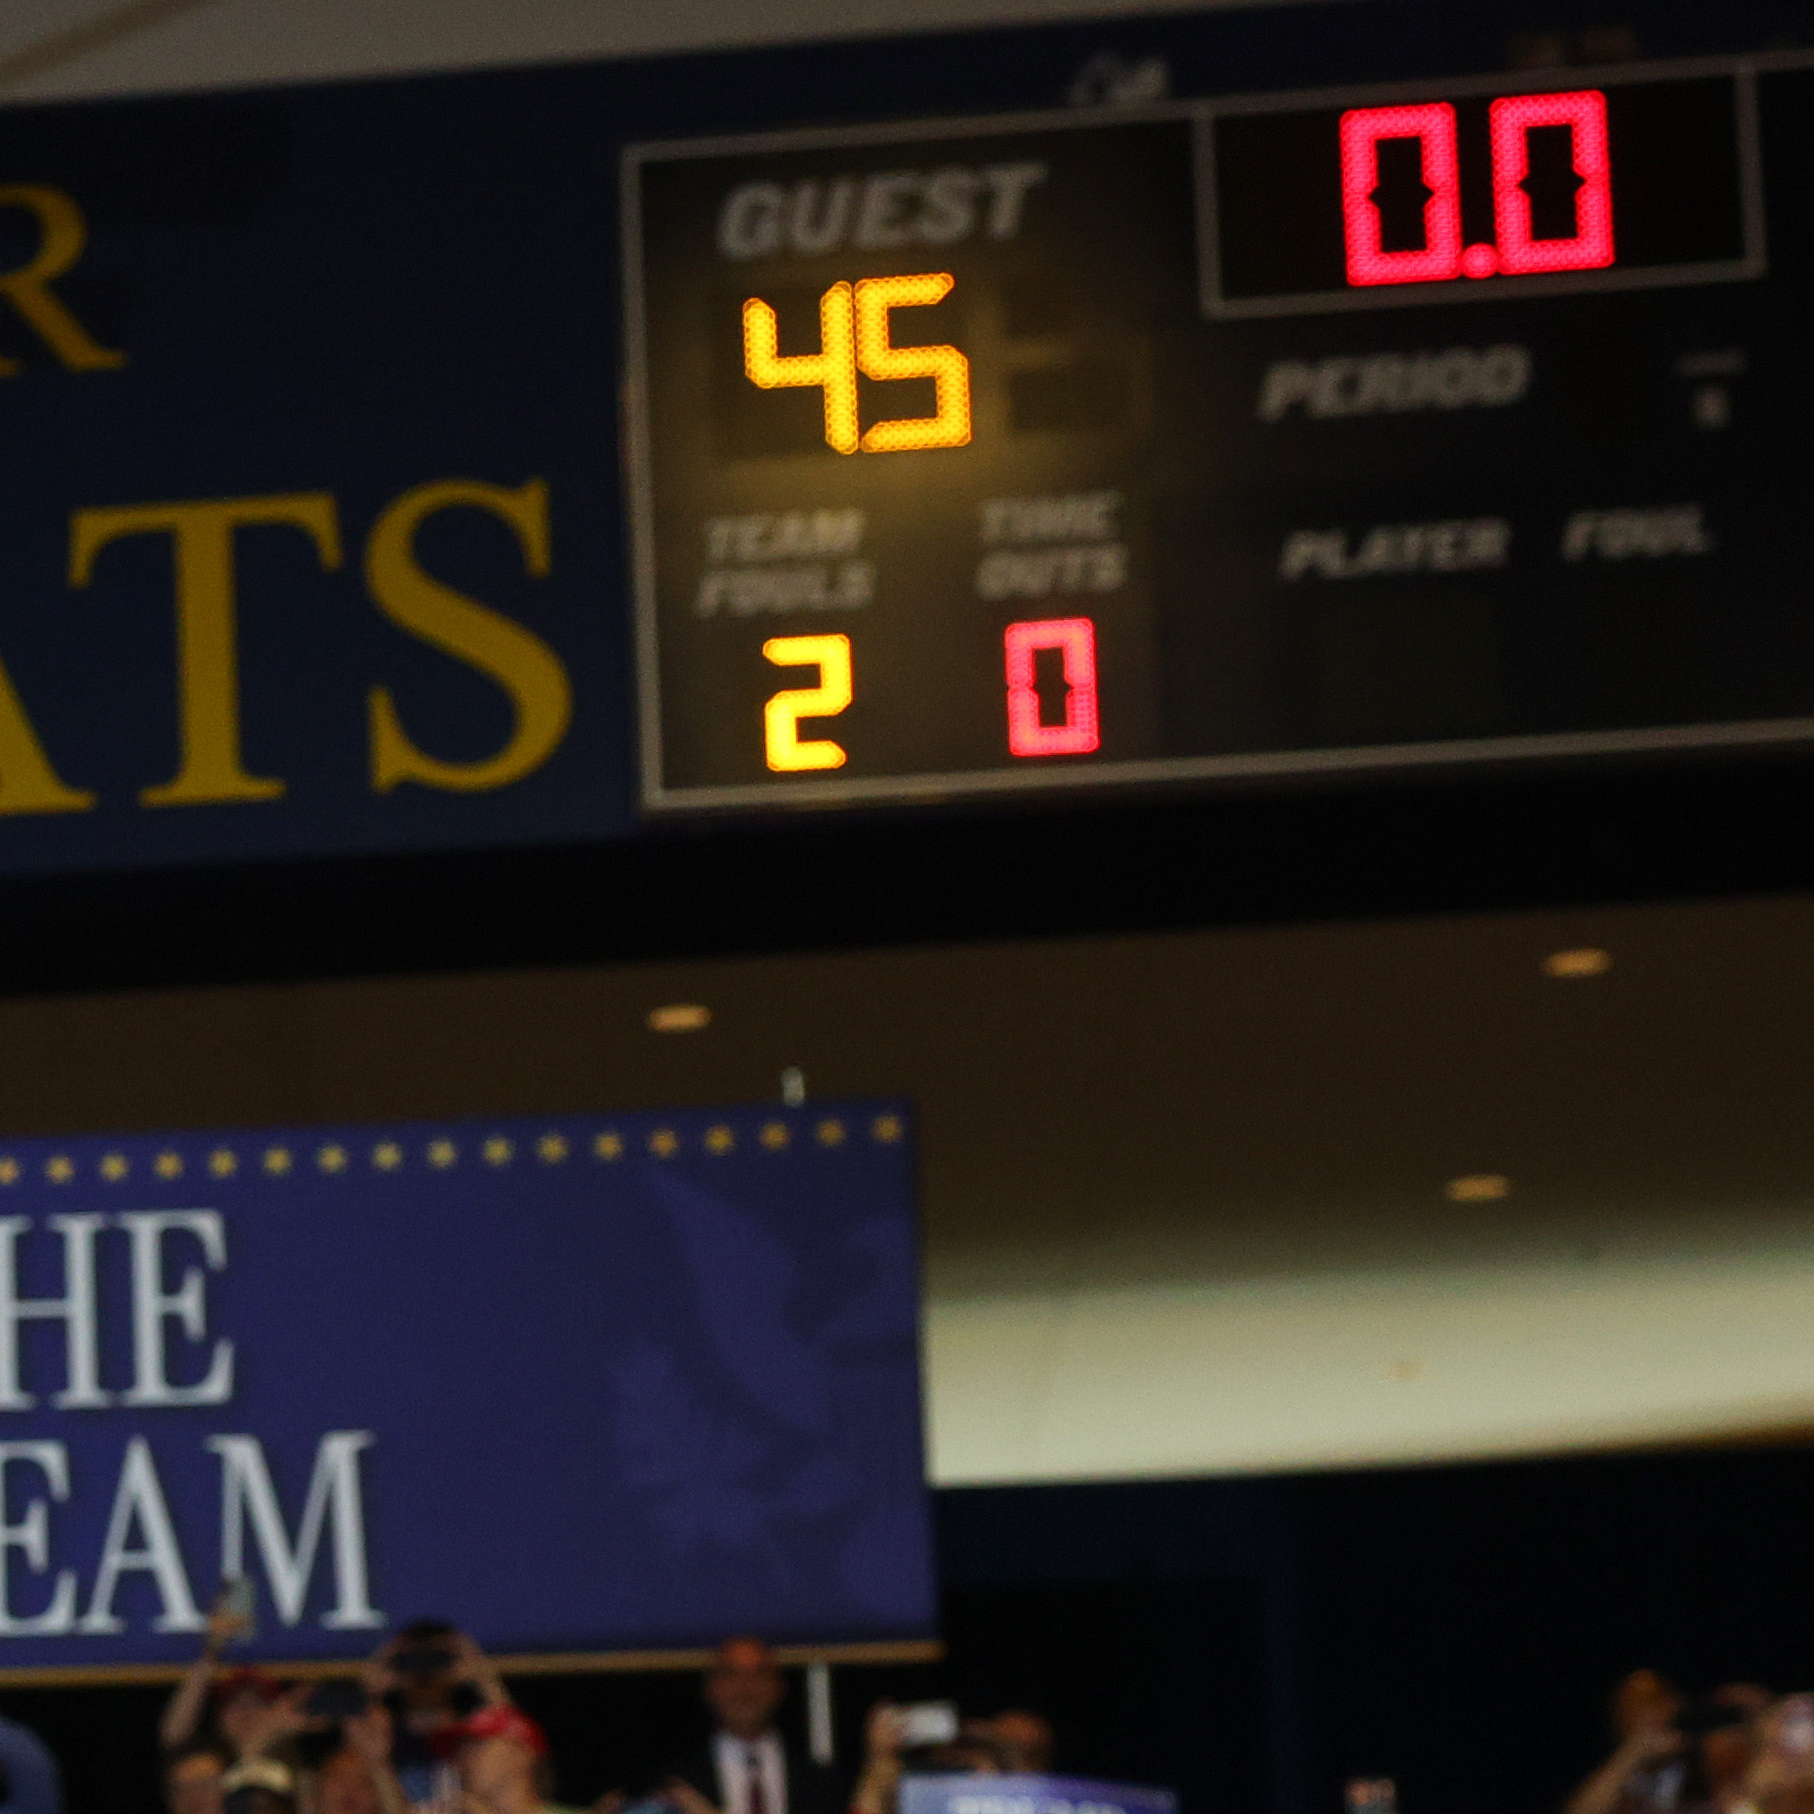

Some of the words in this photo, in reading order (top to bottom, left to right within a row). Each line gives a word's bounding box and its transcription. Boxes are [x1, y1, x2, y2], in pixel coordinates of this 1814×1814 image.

[717, 162, 1049, 260] GUEST
[1339, 90, 1615, 287] 0.0
[741, 271, 972, 456] 45
[1257, 342, 1532, 425] PERIOD
[699, 507, 863, 566] TEAM
[1279, 515, 1513, 581] PLAYER
[762, 634, 853, 773] 2
[1004, 617, 1100, 757] 0
